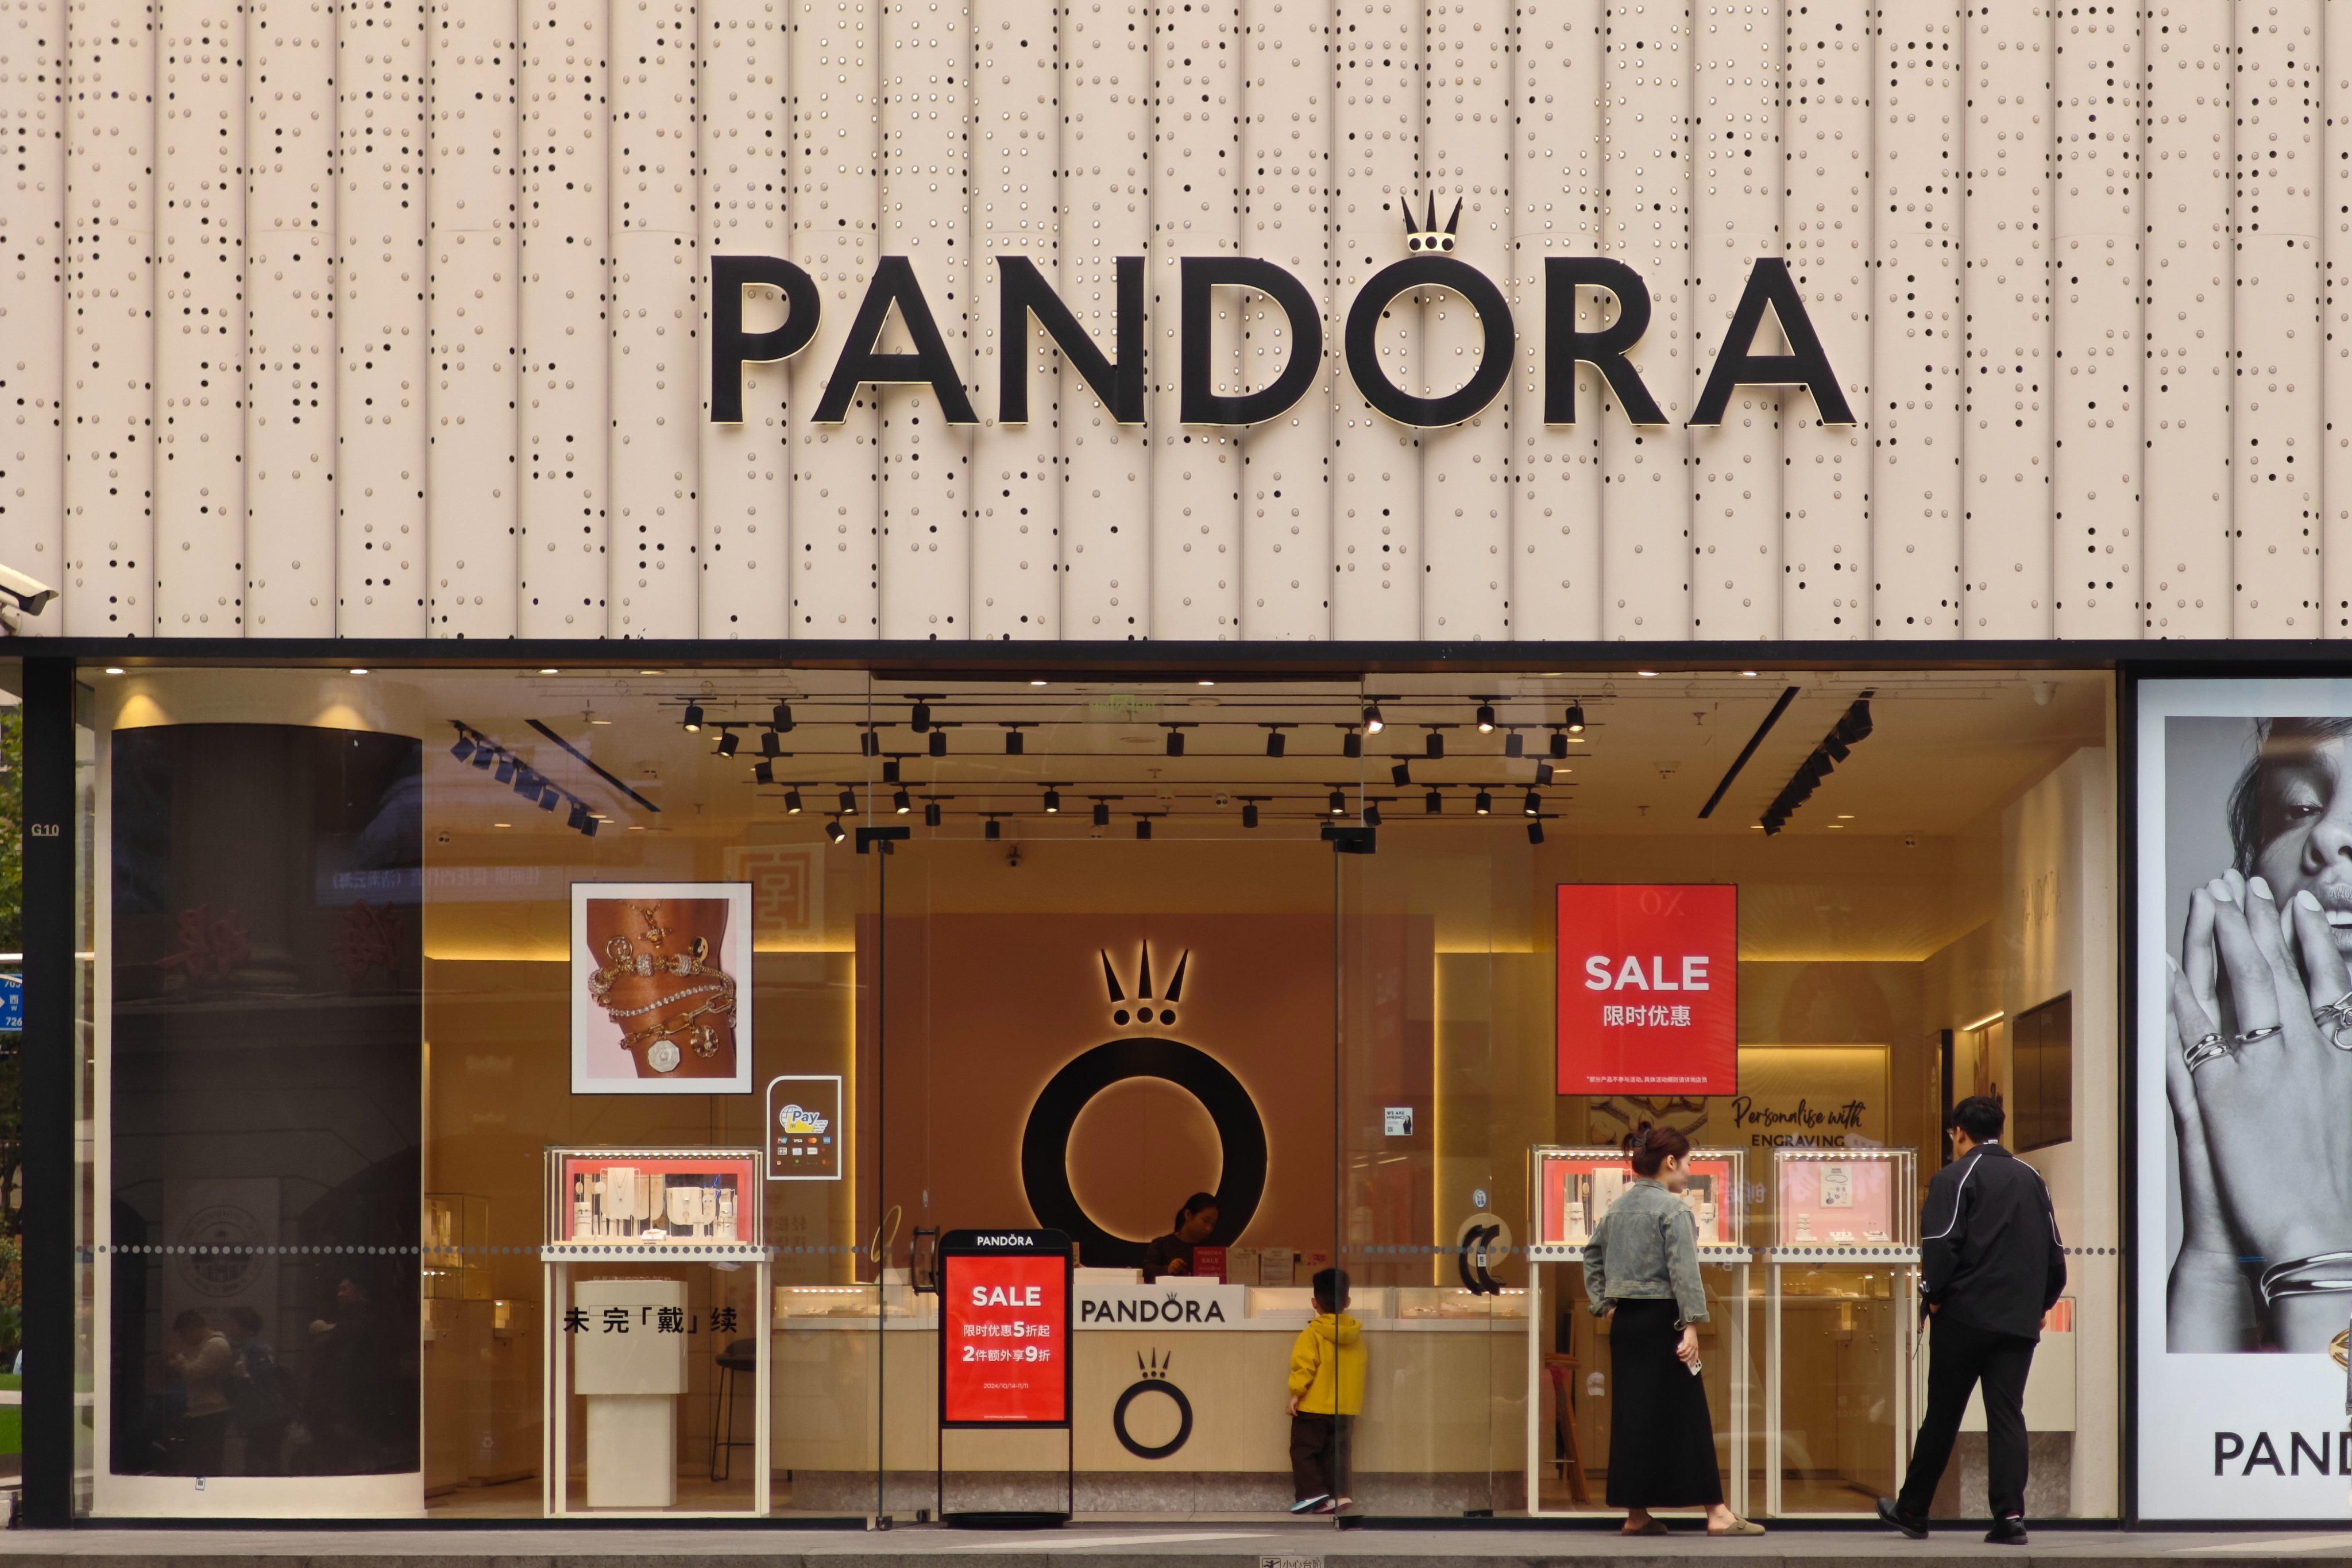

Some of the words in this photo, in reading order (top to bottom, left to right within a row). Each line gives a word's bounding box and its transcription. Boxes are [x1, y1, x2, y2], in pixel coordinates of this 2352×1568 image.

[709, 254, 1859, 428] PANDORA
[31, 823, 59, 835] G10
[1585, 956, 1710, 991] SALE
[5, 1017, 22, 1026] 726
[1603, 1006, 1691, 1026] 限时优惠
[792, 1110, 818, 1125] Pay
[1732, 1096, 1825, 1128] Personalise
[1828, 1100, 1866, 1129] with
[1752, 1134, 1845, 1147] ENGRAVING
[977, 1236, 1034, 1246] PANDORA
[972, 1286, 1041, 1307] SALE
[1081, 1299, 1225, 1323] PANDORA
[963, 1321, 1051, 1338] 限时优惠5折起
[963, 1346, 1051, 1362] 2件额外享9折
